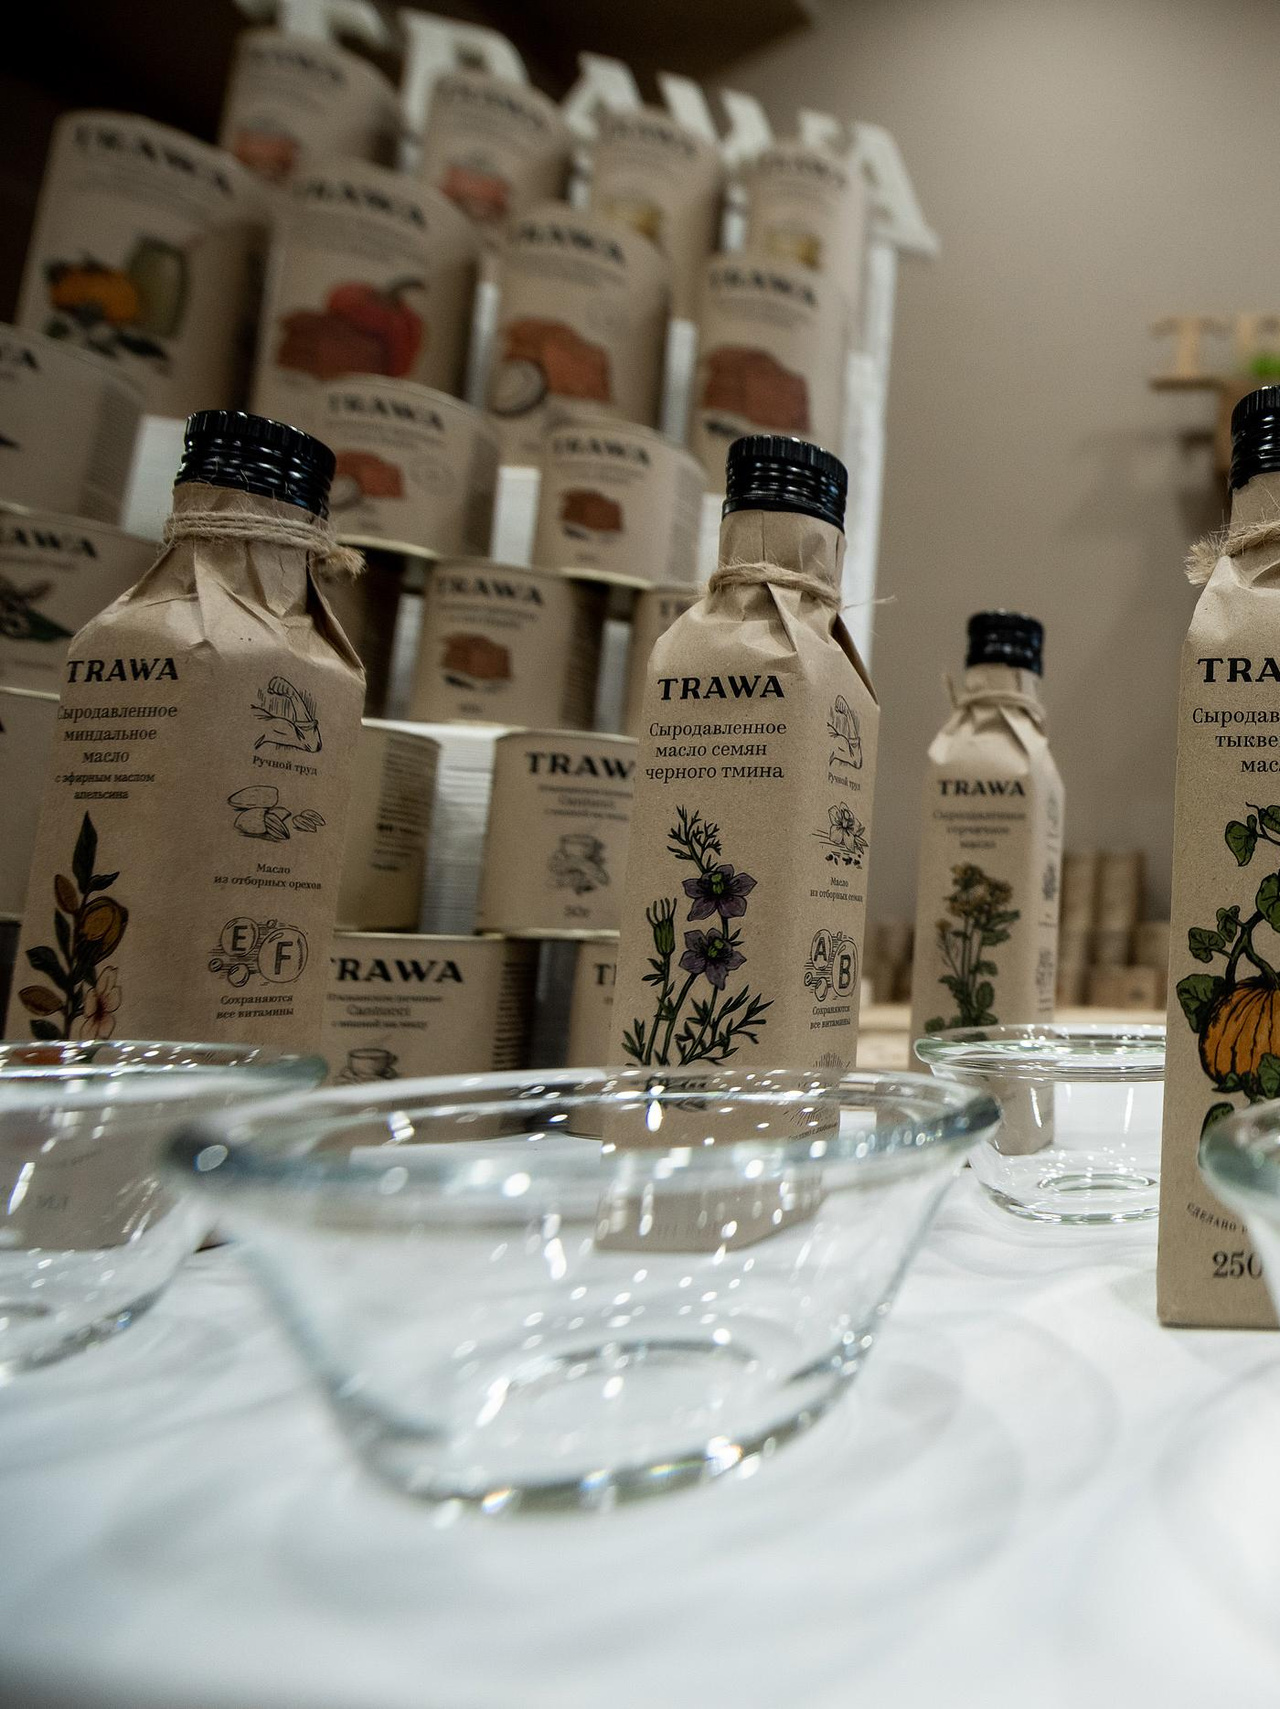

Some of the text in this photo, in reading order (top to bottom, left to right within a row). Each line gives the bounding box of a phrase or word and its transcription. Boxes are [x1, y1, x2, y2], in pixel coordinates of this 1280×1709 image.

[67, 658, 178, 683] TRAWA
[658, 676, 784, 700] TRAWA
[64, 729, 157, 742] миндальное
[649, 722, 787, 740] Сыродавленное
[82, 750, 129, 763] масло
[655, 743, 767, 758] масло семян
[252, 755, 317, 776] Ручной труд
[525, 752, 636, 779] TRAW
[646, 765, 784, 784] черного тмина
[62, 772, 111, 785] эфирным
[114, 774, 155, 783] маслом
[939, 780, 1025, 796] TRAWA
[256, 863, 291, 875] Масло
[214, 875, 322, 891] из отборных орехов
[231, 925, 248, 951] E
[274, 941, 293, 975] F
[814, 936, 829, 962] A
[330, 957, 463, 983] RAWA
[839, 953, 851, 989] B
[220, 994, 293, 1006] Сохраняются
[216, 1007, 294, 1019] все витамины
[1187, 1203, 1236, 1230] СДЕЛАНО
[1212, 1251, 1262, 1280] 250
